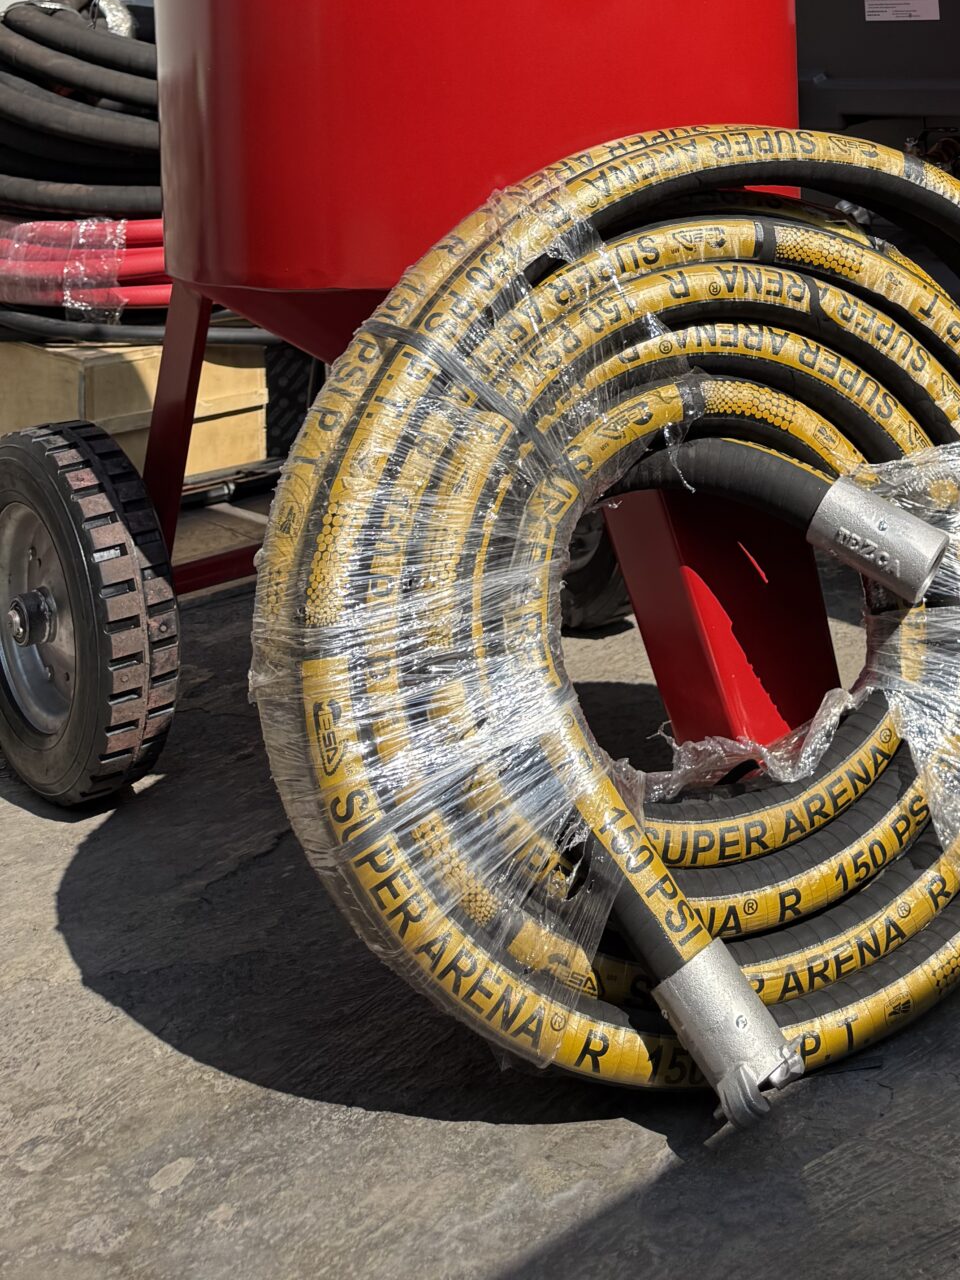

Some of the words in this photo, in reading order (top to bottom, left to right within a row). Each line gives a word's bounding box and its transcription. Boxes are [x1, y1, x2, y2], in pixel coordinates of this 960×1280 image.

[706, 129, 817, 158] SUPER
[659, 270, 691, 299] R
[798, 337, 900, 420] SUPER
[599, 806, 654, 873] 150
[645, 881, 702, 948] PSI
[778, 888, 802, 923] R
[834, 838, 887, 893] 150
[926, 871, 952, 914] R
[574, 1028, 610, 1073] R
